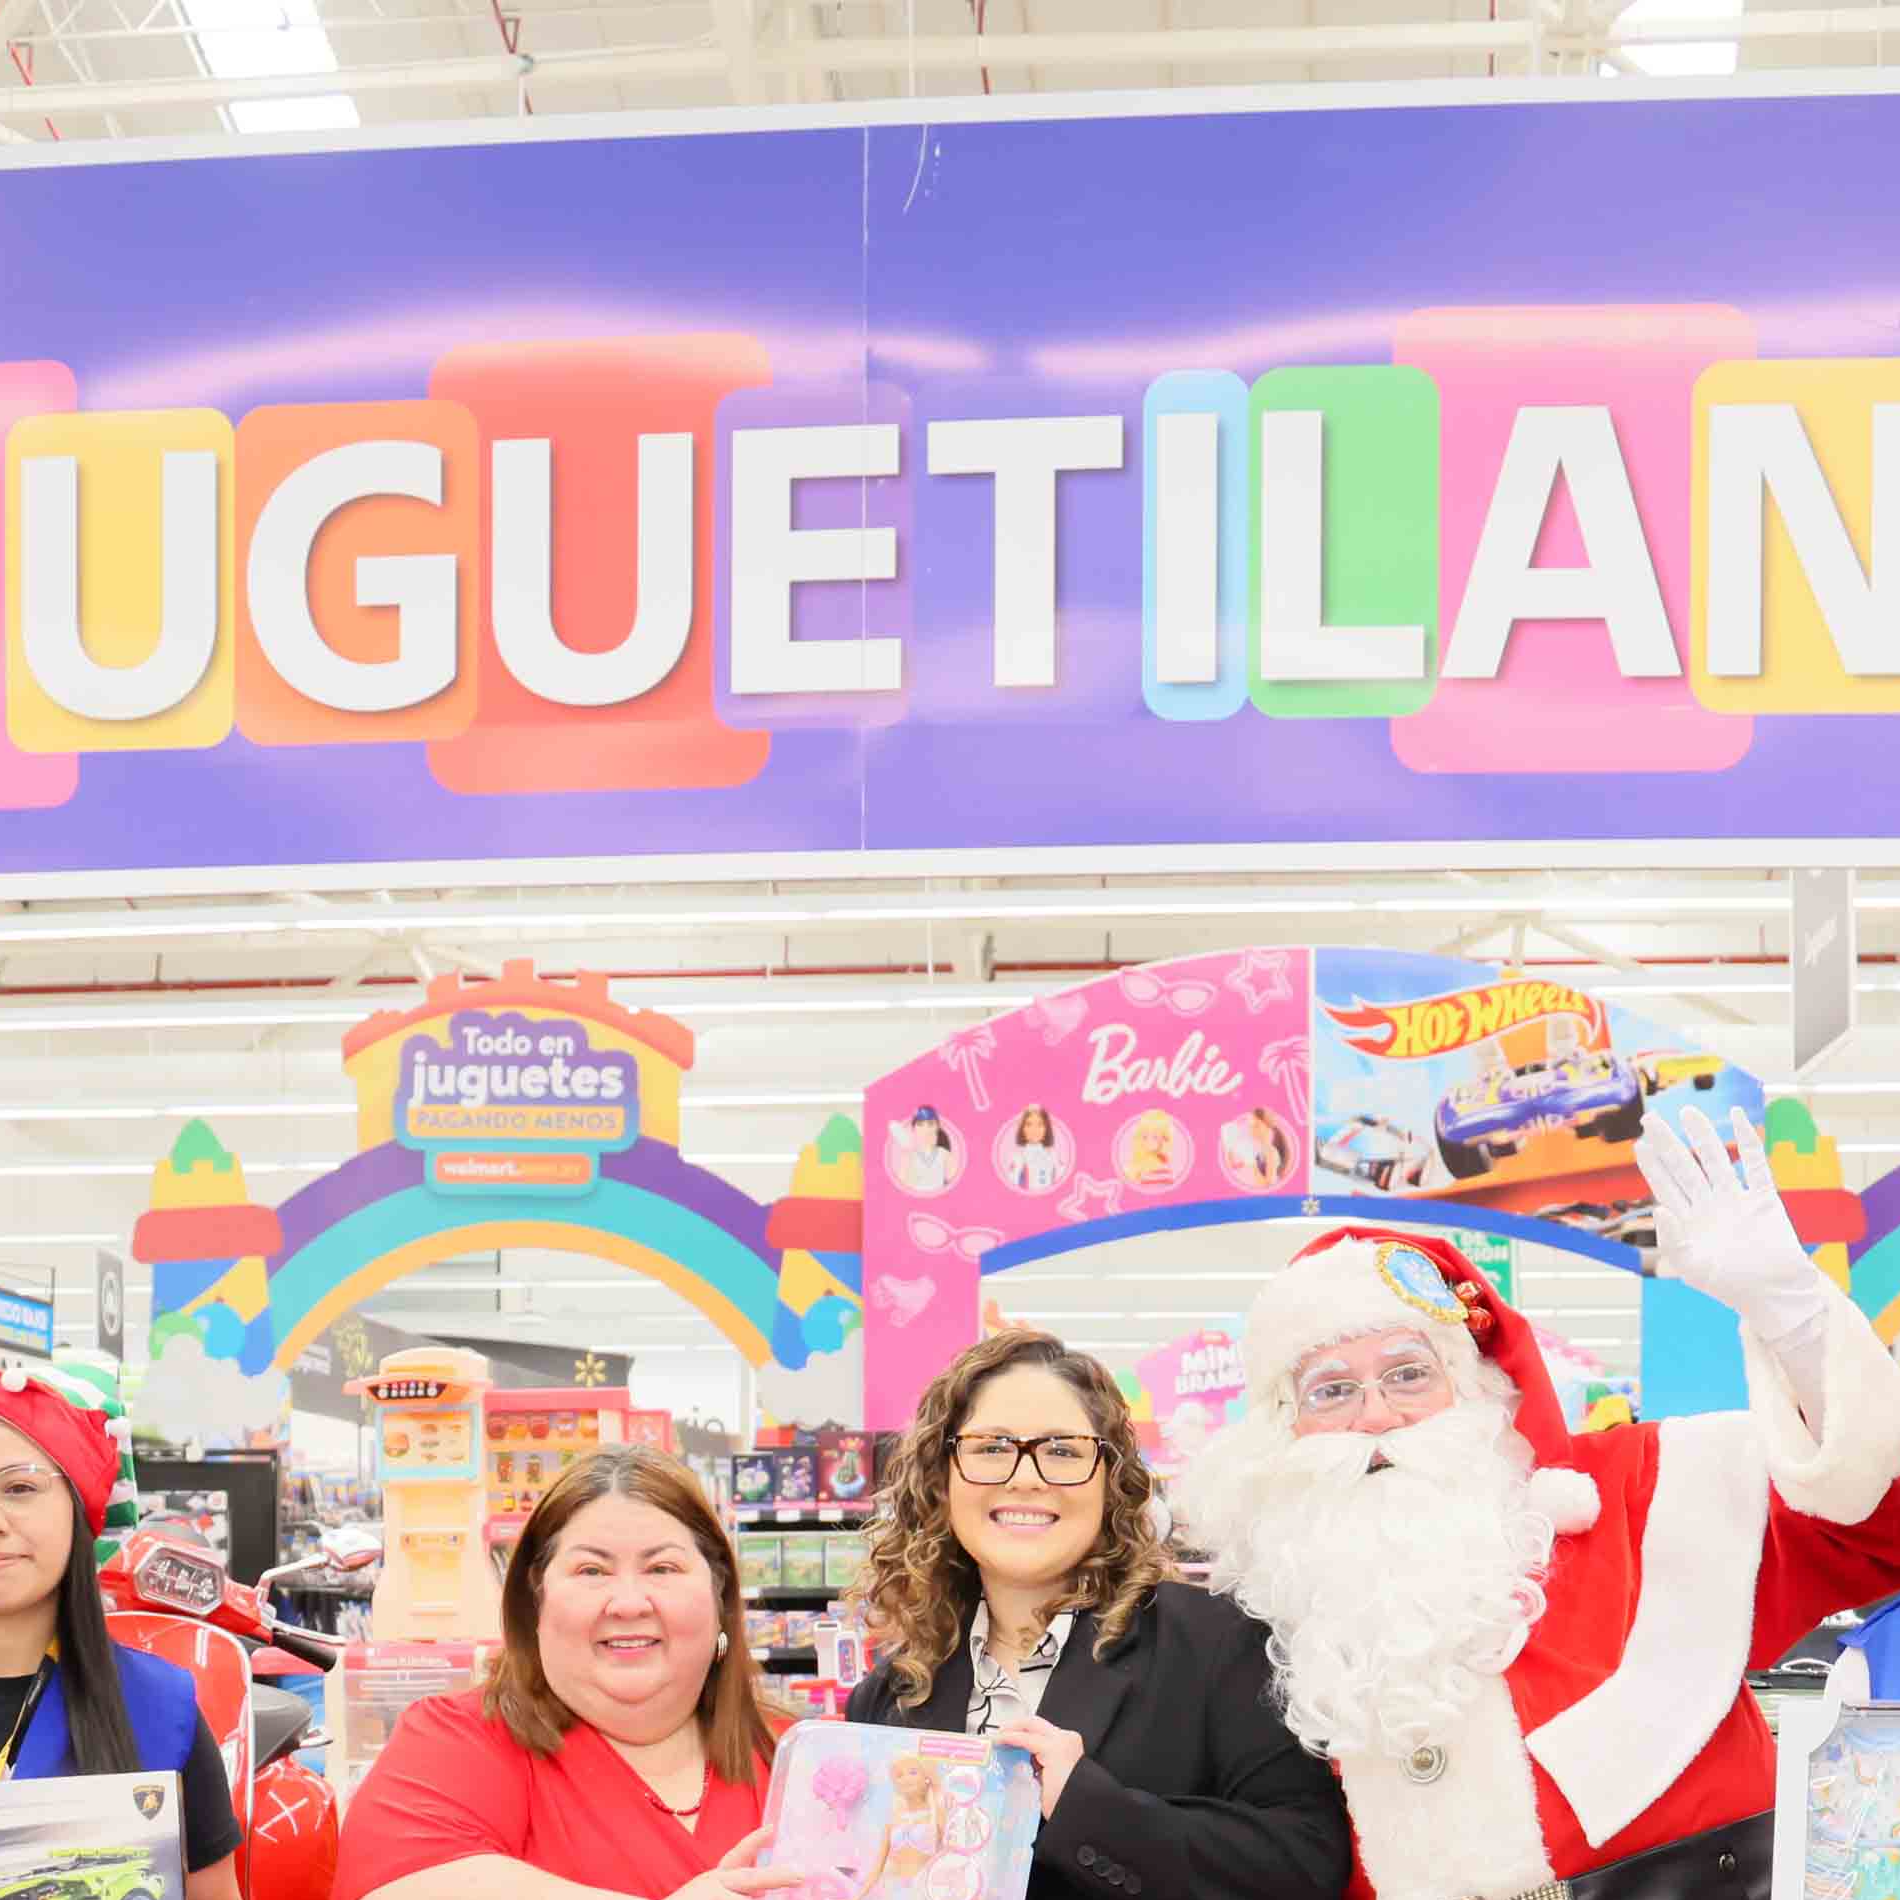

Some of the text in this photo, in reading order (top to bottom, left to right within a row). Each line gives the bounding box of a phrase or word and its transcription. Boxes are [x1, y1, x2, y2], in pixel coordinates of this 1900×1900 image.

[462, 1026, 575, 1056] Todo en
[407, 1050, 625, 1109] juguetes
[1082, 1023, 1243, 1105] Barbie
[417, 1111, 617, 1131] PAGANDO MENOS
